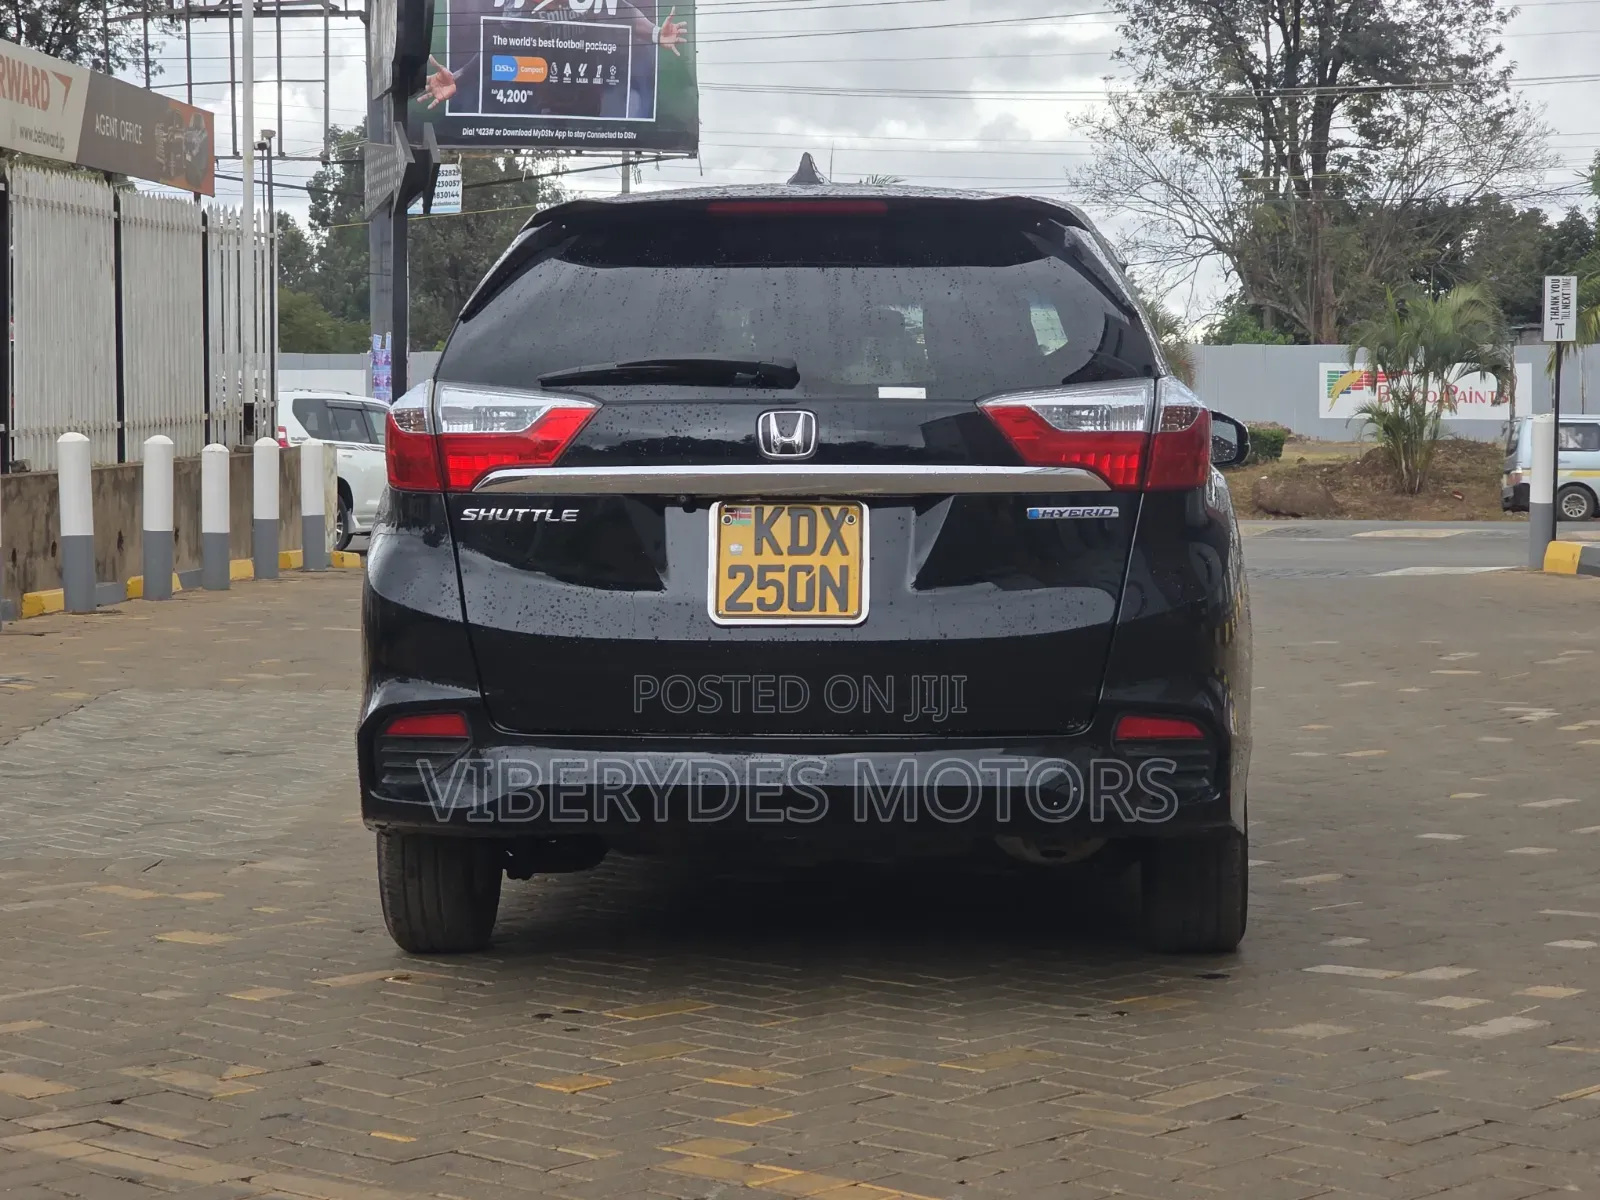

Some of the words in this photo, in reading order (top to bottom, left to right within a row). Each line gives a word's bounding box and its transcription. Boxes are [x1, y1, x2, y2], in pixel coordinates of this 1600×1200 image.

[493, 35, 507, 46] The
[509, 36, 537, 47] world's
[538, 38, 555, 48] best
[556, 38, 584, 50] football
[585, 41, 617, 54] package
[494, 64, 516, 72] DStv
[520, 66, 544, 74] Compact
[496, 89, 528, 104] 4,200
[95, 113, 118, 138] AGENT
[120, 120, 142, 144] OFFICE
[462, 127, 475, 136] Dial
[502, 128, 532, 137] Download
[533, 129, 554, 139] MyDStv
[554, 129, 566, 139] App
[567, 130, 573, 138] to
[574, 130, 586, 140] stay
[587, 131, 617, 139] Connected
[617, 131, 623, 139] to
[624, 131, 637, 139] DStv
[1550, 278, 1560, 293] YOU
[1561, 277, 1572, 291] TIME
[1550, 295, 1560, 320] THANK
[1561, 292, 1571, 310] NEXT
[1561, 310, 1571, 320] TILL
[460, 508, 580, 522] SHUTTLE
[1041, 508, 1114, 518] HYBRID
[754, 506, 850, 556] KDX
[725, 564, 849, 612] 250N
